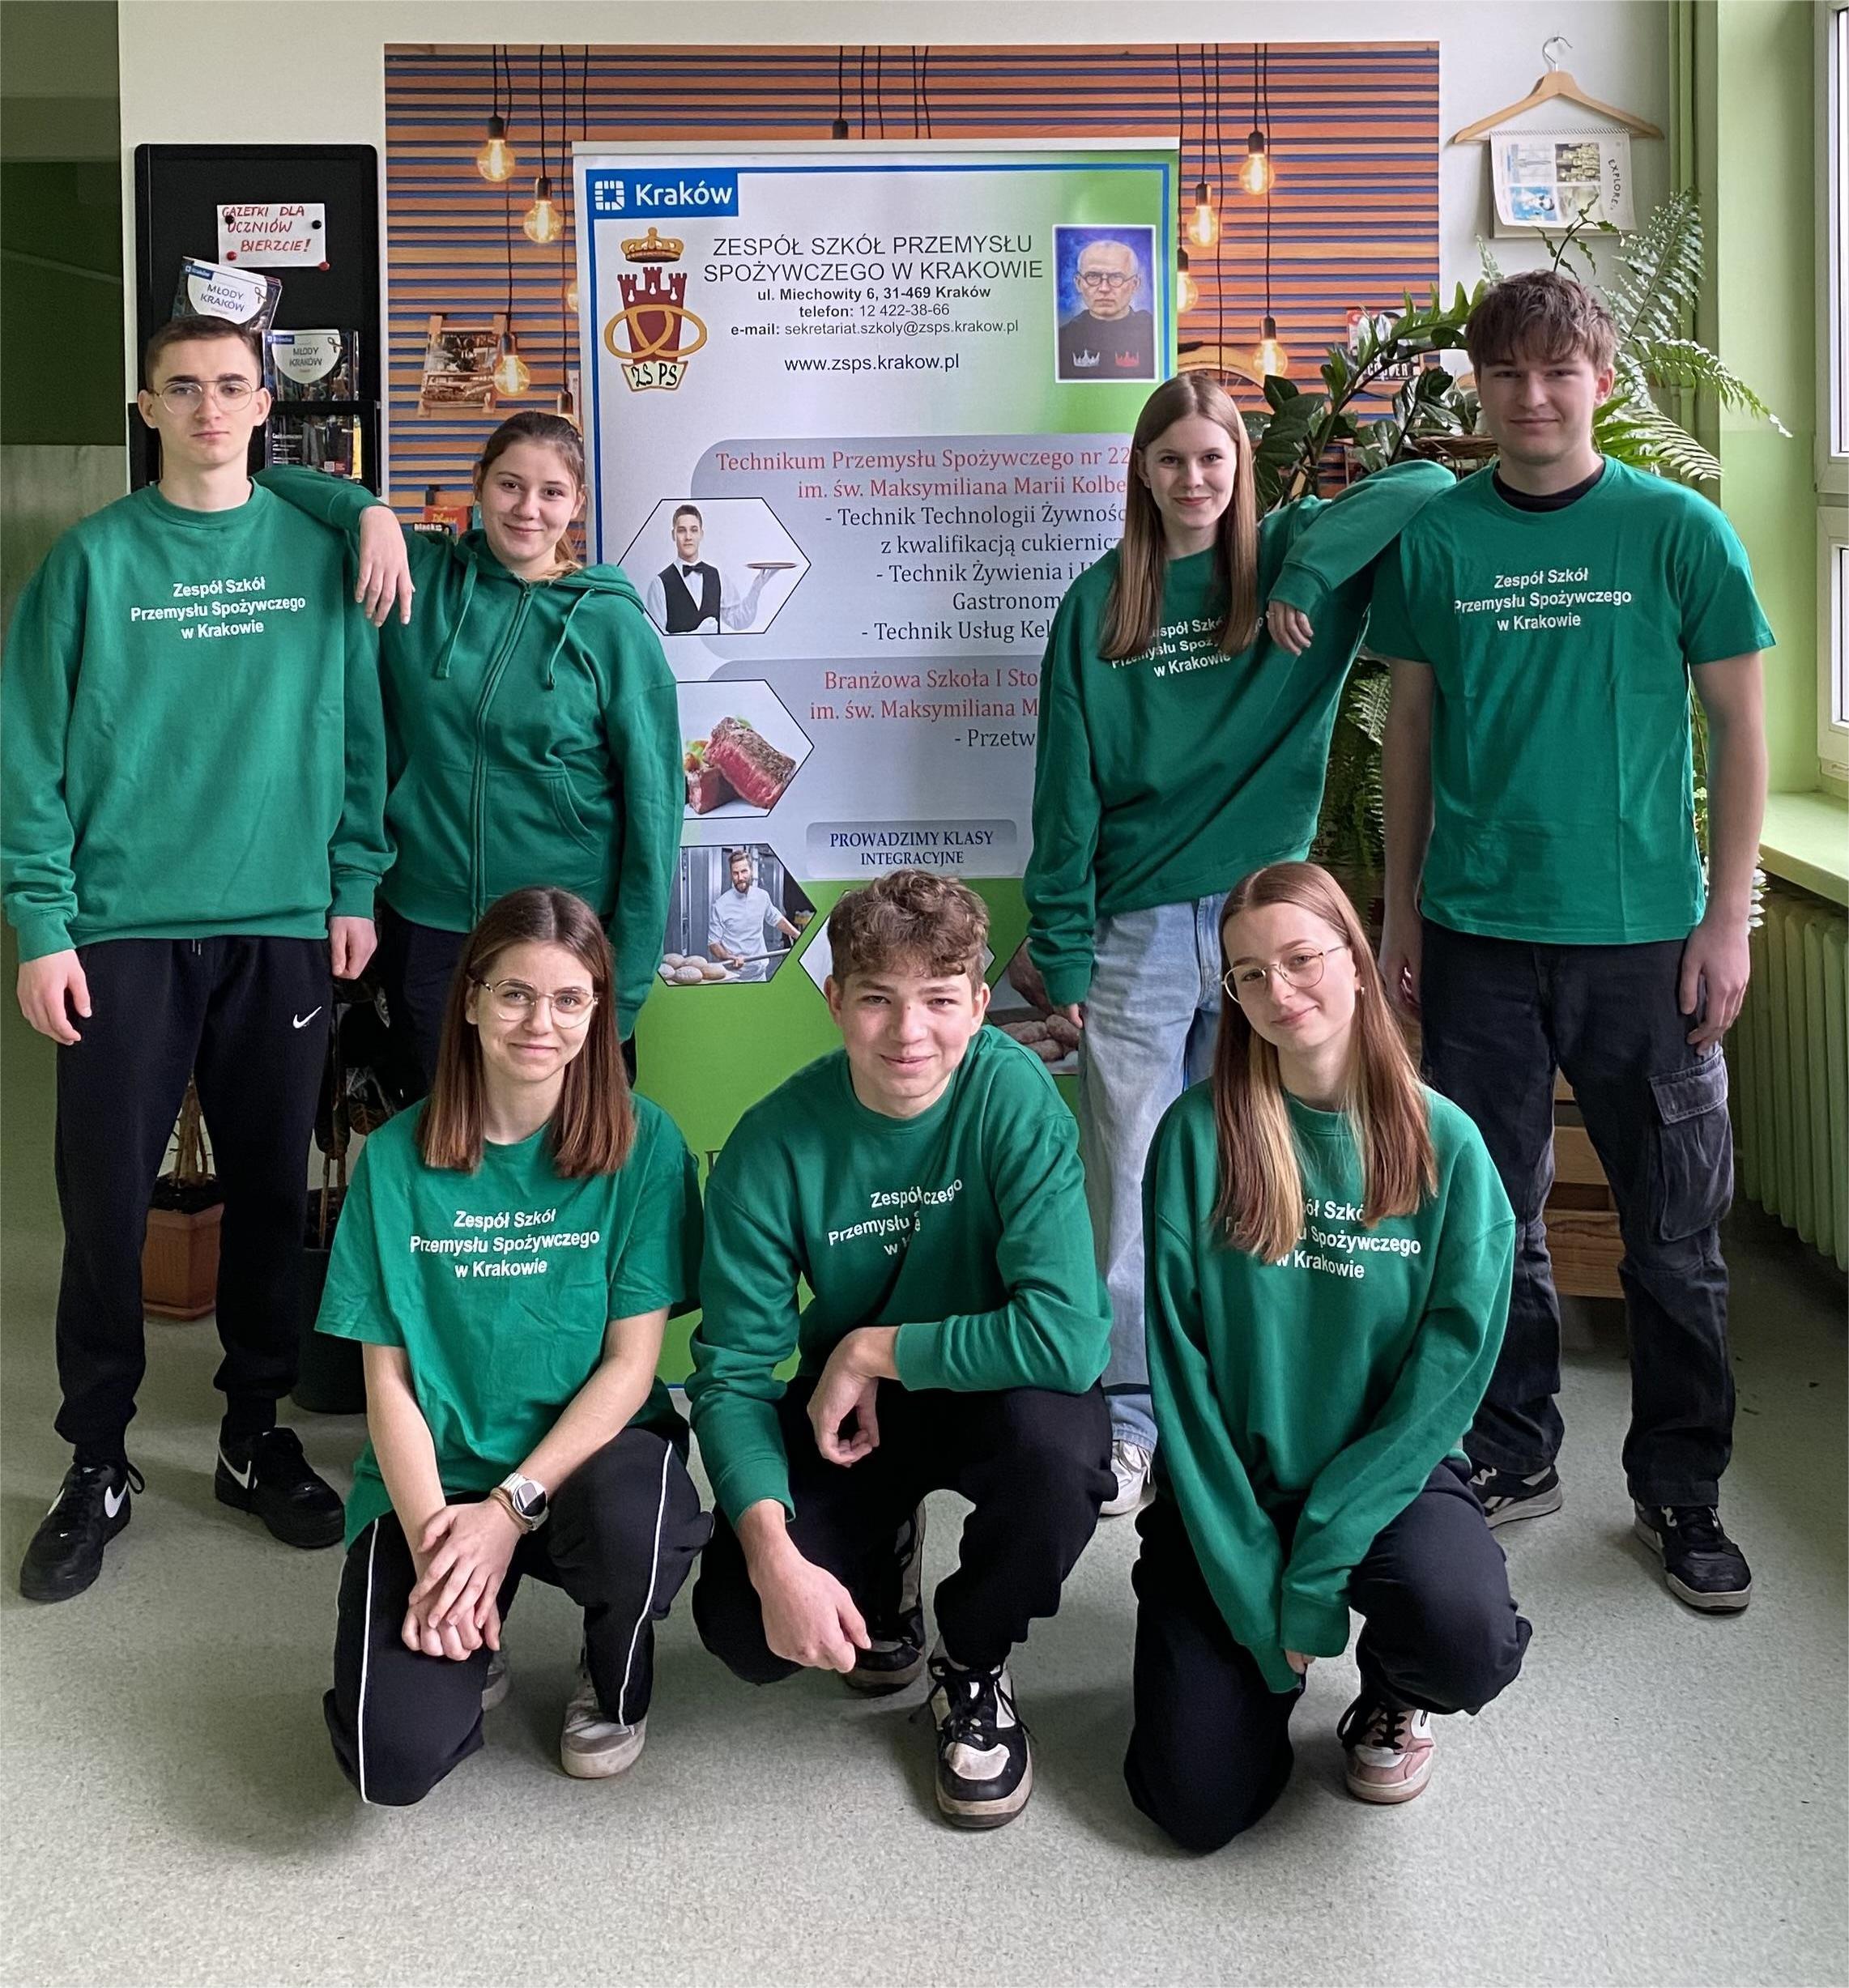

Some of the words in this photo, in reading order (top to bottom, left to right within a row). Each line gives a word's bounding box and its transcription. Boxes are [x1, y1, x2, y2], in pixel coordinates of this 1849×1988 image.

[636, 180, 732, 206] Kraków
[222, 206, 268, 218] GAZETKI
[279, 206, 305, 216] DLA
[228, 218, 292, 233] UCZNIÓW
[241, 238, 311, 252] BIERZCIE!
[713, 234, 804, 256] ZESPÓŁ
[812, 233, 885, 255] SZKÓŁ
[893, 235, 1032, 254] PRZEMYSŁU
[704, 261, 884, 282] SPOŻYWCZEGO
[892, 262, 913, 280] W
[921, 260, 1043, 279] KRAKOWIE
[207, 283, 244, 300] MŁODY
[757, 288, 775, 301] ul.
[780, 287, 862, 303] Miechowity
[867, 287, 879, 301] 6,
[884, 287, 931, 299] 31-469
[936, 285, 991, 298] Kraków
[799, 305, 854, 317] telefon:
[860, 304, 876, 317] 12
[880, 303, 950, 317] 422-38-66
[731, 323, 780, 335] e-mail:
[785, 319, 1018, 336] sekretariat.szkoly@zsps.krakow.pl
[785, 353, 959, 374] www.zsps.krakow.pl
[716, 452, 825, 470] Technikum
[833, 449, 935, 473] Przemysłu
[942, 449, 1074, 471] Spożywczego
[1081, 452, 1102, 465] nr
[1108, 447, 1130, 465] 22
[798, 481, 828, 498] im.
[833, 479, 863, 497] św.
[871, 477, 1008, 500] Maksymiliana
[1014, 476, 1065, 495] Marii
[1072, 475, 1126, 493] Kolbe
[837, 507, 916, 526] Technik
[922, 505, 1036, 528] Technologii
[881, 540, 892, 554] z
[897, 535, 1015, 556] kwalifikacją
[889, 564, 967, 582] Technik
[973, 560, 1063, 585] Żywienia
[1068, 562, 1074, 579] i
[1493, 570, 1544, 590] Zespół
[1548, 567, 1589, 583] Szkół
[173, 580, 223, 598] Zespół
[225, 577, 266, 594] Szkół
[130, 602, 208, 622] Przemysłu
[211, 597, 306, 617] Spożywczego
[953, 591, 1066, 610] Gastronom
[1454, 594, 1525, 615] Przemysłu
[1529, 590, 1632, 610] Spożywczego
[181, 627, 194, 639] w
[198, 619, 264, 638] Krakowie
[874, 622, 952, 640] Technik
[958, 620, 1015, 643] Usług
[1192, 616, 1224, 633] Szk
[1497, 619, 1510, 631] w
[1513, 611, 1582, 631] Krakowie
[824, 671, 921, 689] Branżowa
[927, 669, 989, 687] Szkoła
[996, 669, 1002, 687] I
[1153, 664, 1166, 678] w
[811, 702, 839, 720] im.
[846, 700, 875, 718] św.
[881, 698, 1015, 722] Maksymiliana
[968, 728, 1036, 747] Przetw
[830, 832, 939, 847] PROWADZIMY
[944, 831, 994, 845] KLASY
[861, 851, 965, 866] INTEGRACYJNE
[453, 1210, 509, 1232] Zespół
[513, 1207, 556, 1228] Szkół
[1323, 1200, 1365, 1222] Szkó
[828, 1214, 910, 1246] Przemysłu
[1311, 1225, 1421, 1256] Spożywczego
[409, 1235, 488, 1257] Przemysłu
[492, 1229, 600, 1254] Spożywczego
[884, 1243, 898, 1255] w
[454, 1264, 468, 1278] w
[472, 1257, 547, 1278] Krakowie
[1293, 1249, 1365, 1279] Krakowie
